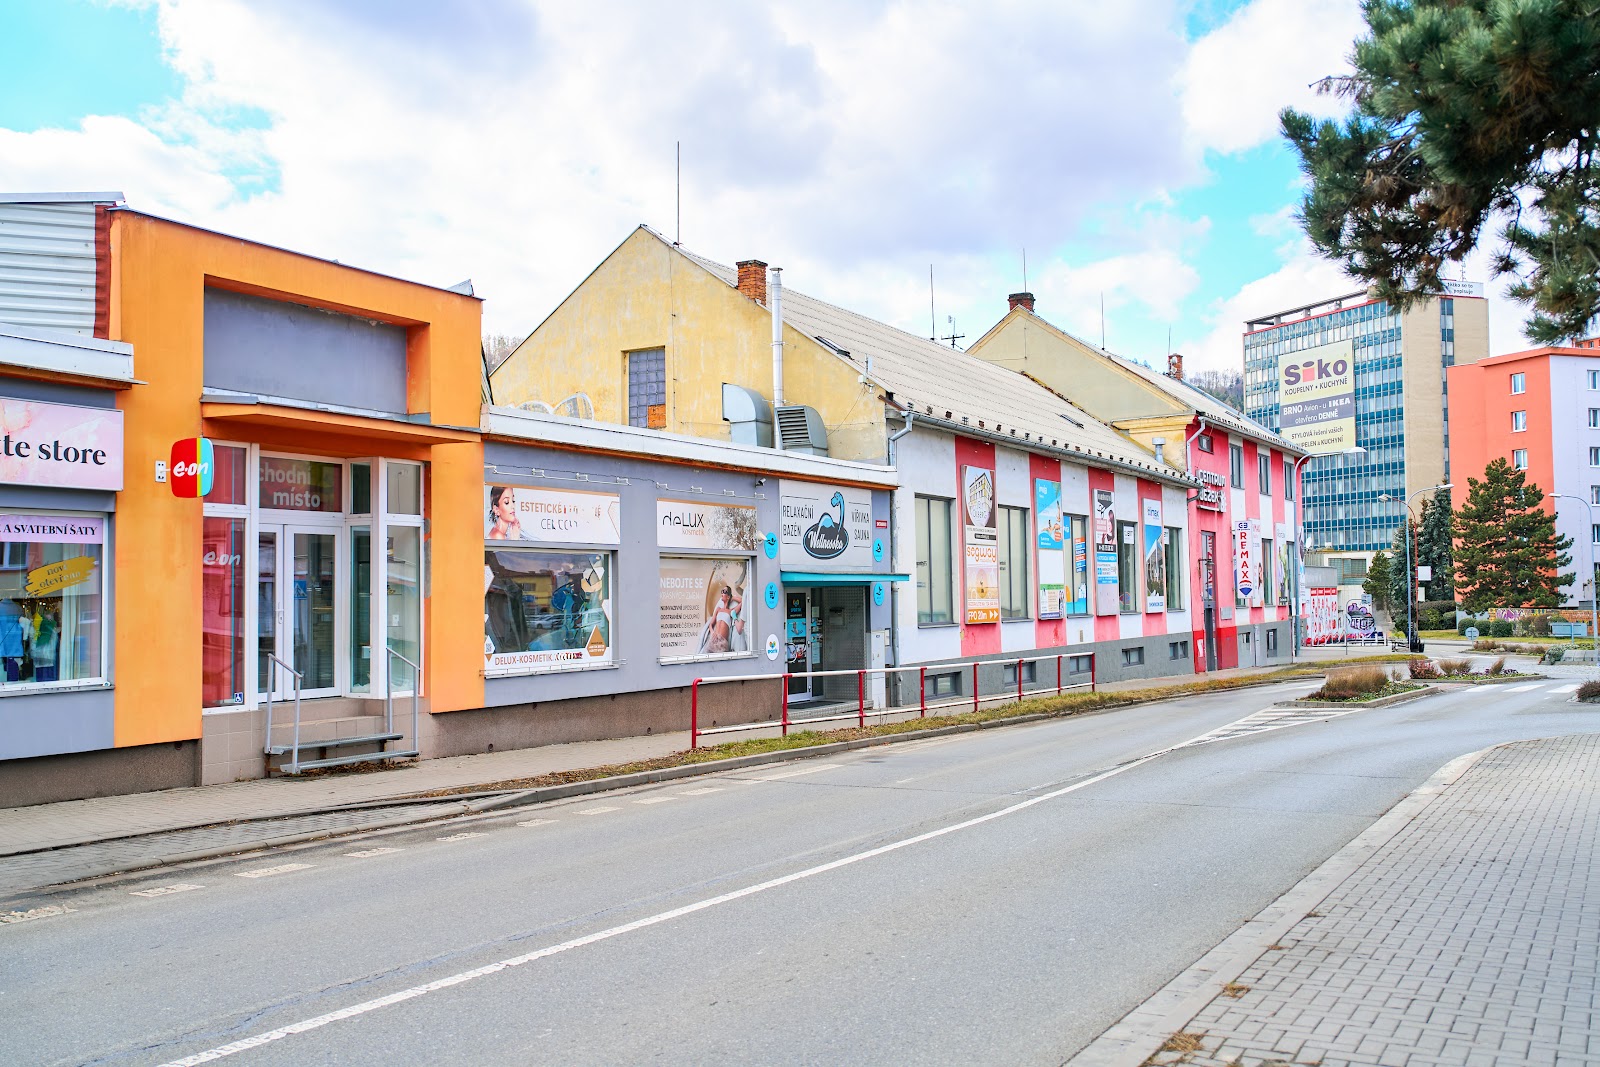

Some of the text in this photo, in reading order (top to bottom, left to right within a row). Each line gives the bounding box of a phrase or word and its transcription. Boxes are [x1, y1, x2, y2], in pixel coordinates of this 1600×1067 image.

[1284, 376, 1348, 396] KOUPELNY KUCHYNĚ
[1283, 404, 1303, 416] BRNO
[1303, 403, 1319, 412] Avion
[1328, 397, 1351, 408] IKEA
[1318, 408, 1339, 420] DENNĚ
[1291, 429, 1313, 439] STYLOVÁ
[1320, 434, 1344, 446] KUCHYNÍ
[0, 434, 107, 466] te store
[273, 486, 321, 508] místo
[520, 501, 562, 514] ESTETICKÉ
[782, 505, 815, 520] RELAXAČNÍ
[3, 523, 98, 536] A SVATEBNÍ ŠATY
[782, 522, 870, 541] BAZÉN SAUNA
[966, 546, 997, 562] segway
[1239, 531, 1249, 579] REMAX
[659, 577, 704, 589] NEBOJTE SE
[967, 610, 978, 621] FPO
